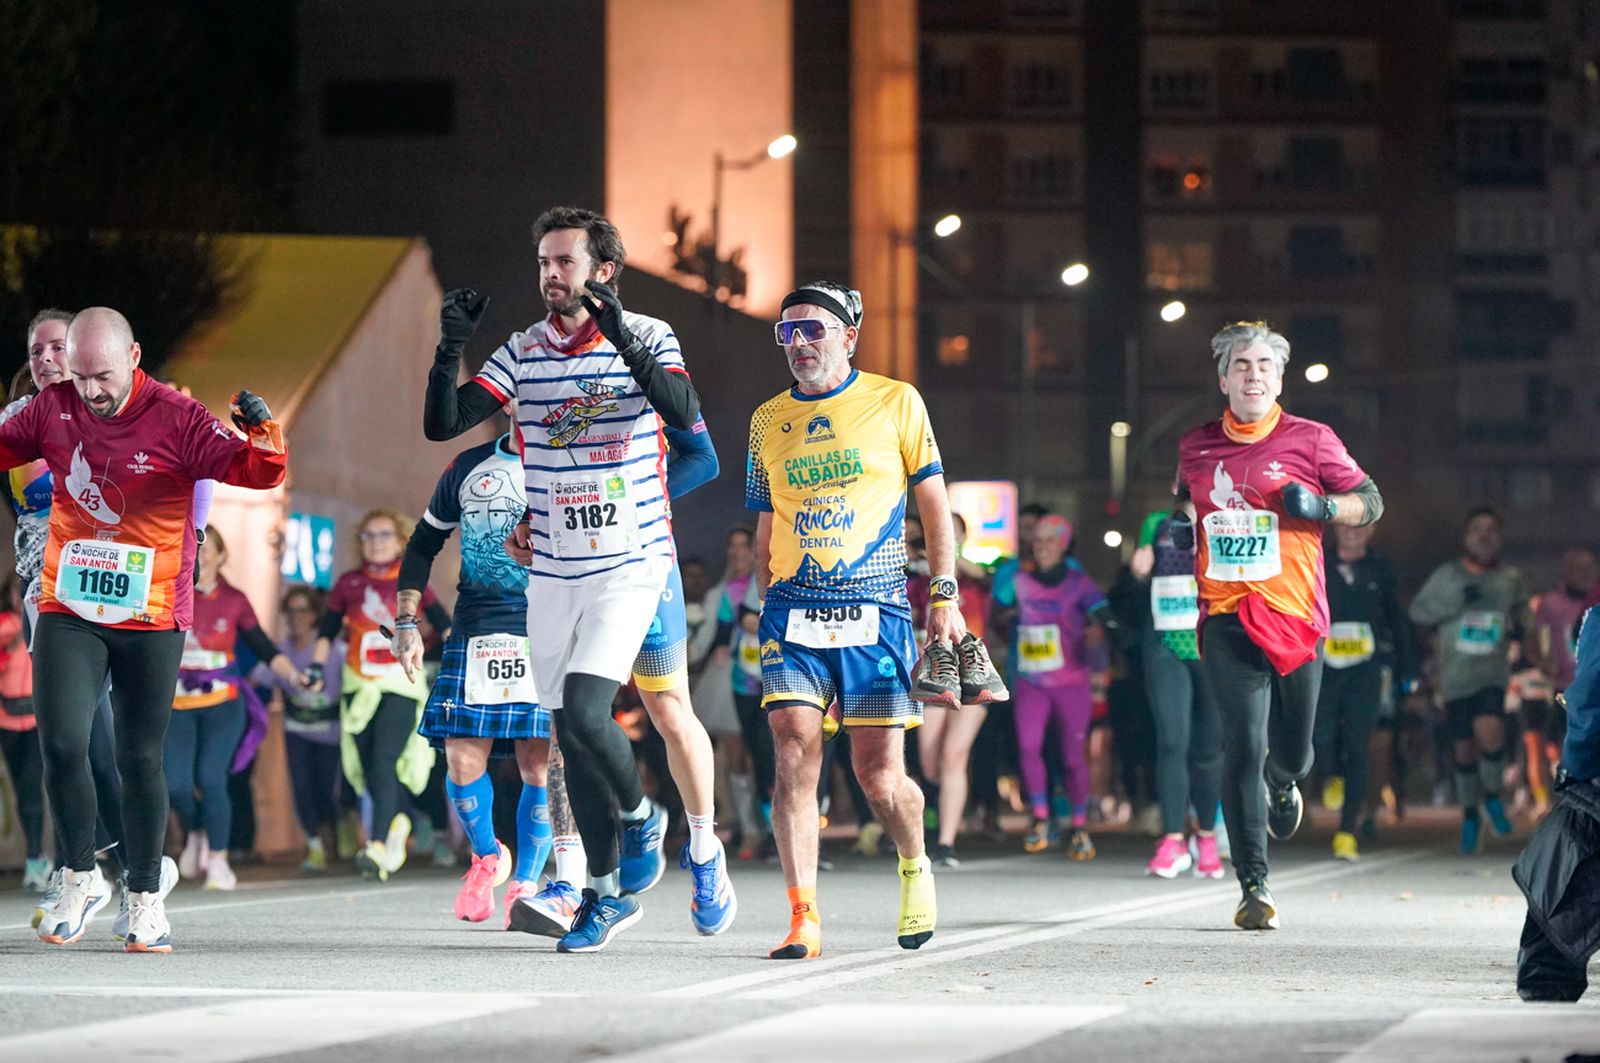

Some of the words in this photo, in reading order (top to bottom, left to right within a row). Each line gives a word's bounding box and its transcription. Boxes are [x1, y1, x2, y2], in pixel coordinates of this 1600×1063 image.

[785, 450, 841, 472] CANILLAS
[844, 448, 860, 461] DE
[787, 461, 864, 486] ALBAIDA
[79, 488, 100, 511] 43
[564, 485, 585, 494] NOCHE
[588, 484, 598, 492] DE
[555, 496, 570, 505] SAN
[564, 503, 619, 530] 3182
[800, 538, 844, 549] DENTAL
[1216, 536, 1267, 557] 12227
[70, 556, 87, 567] SAN
[89, 559, 119, 571] ANTÓN
[81, 549, 108, 559] NOCHE
[109, 552, 119, 561] DE
[78, 569, 130, 598] 1169
[475, 651, 490, 659] SAN
[487, 658, 526, 680] 655
